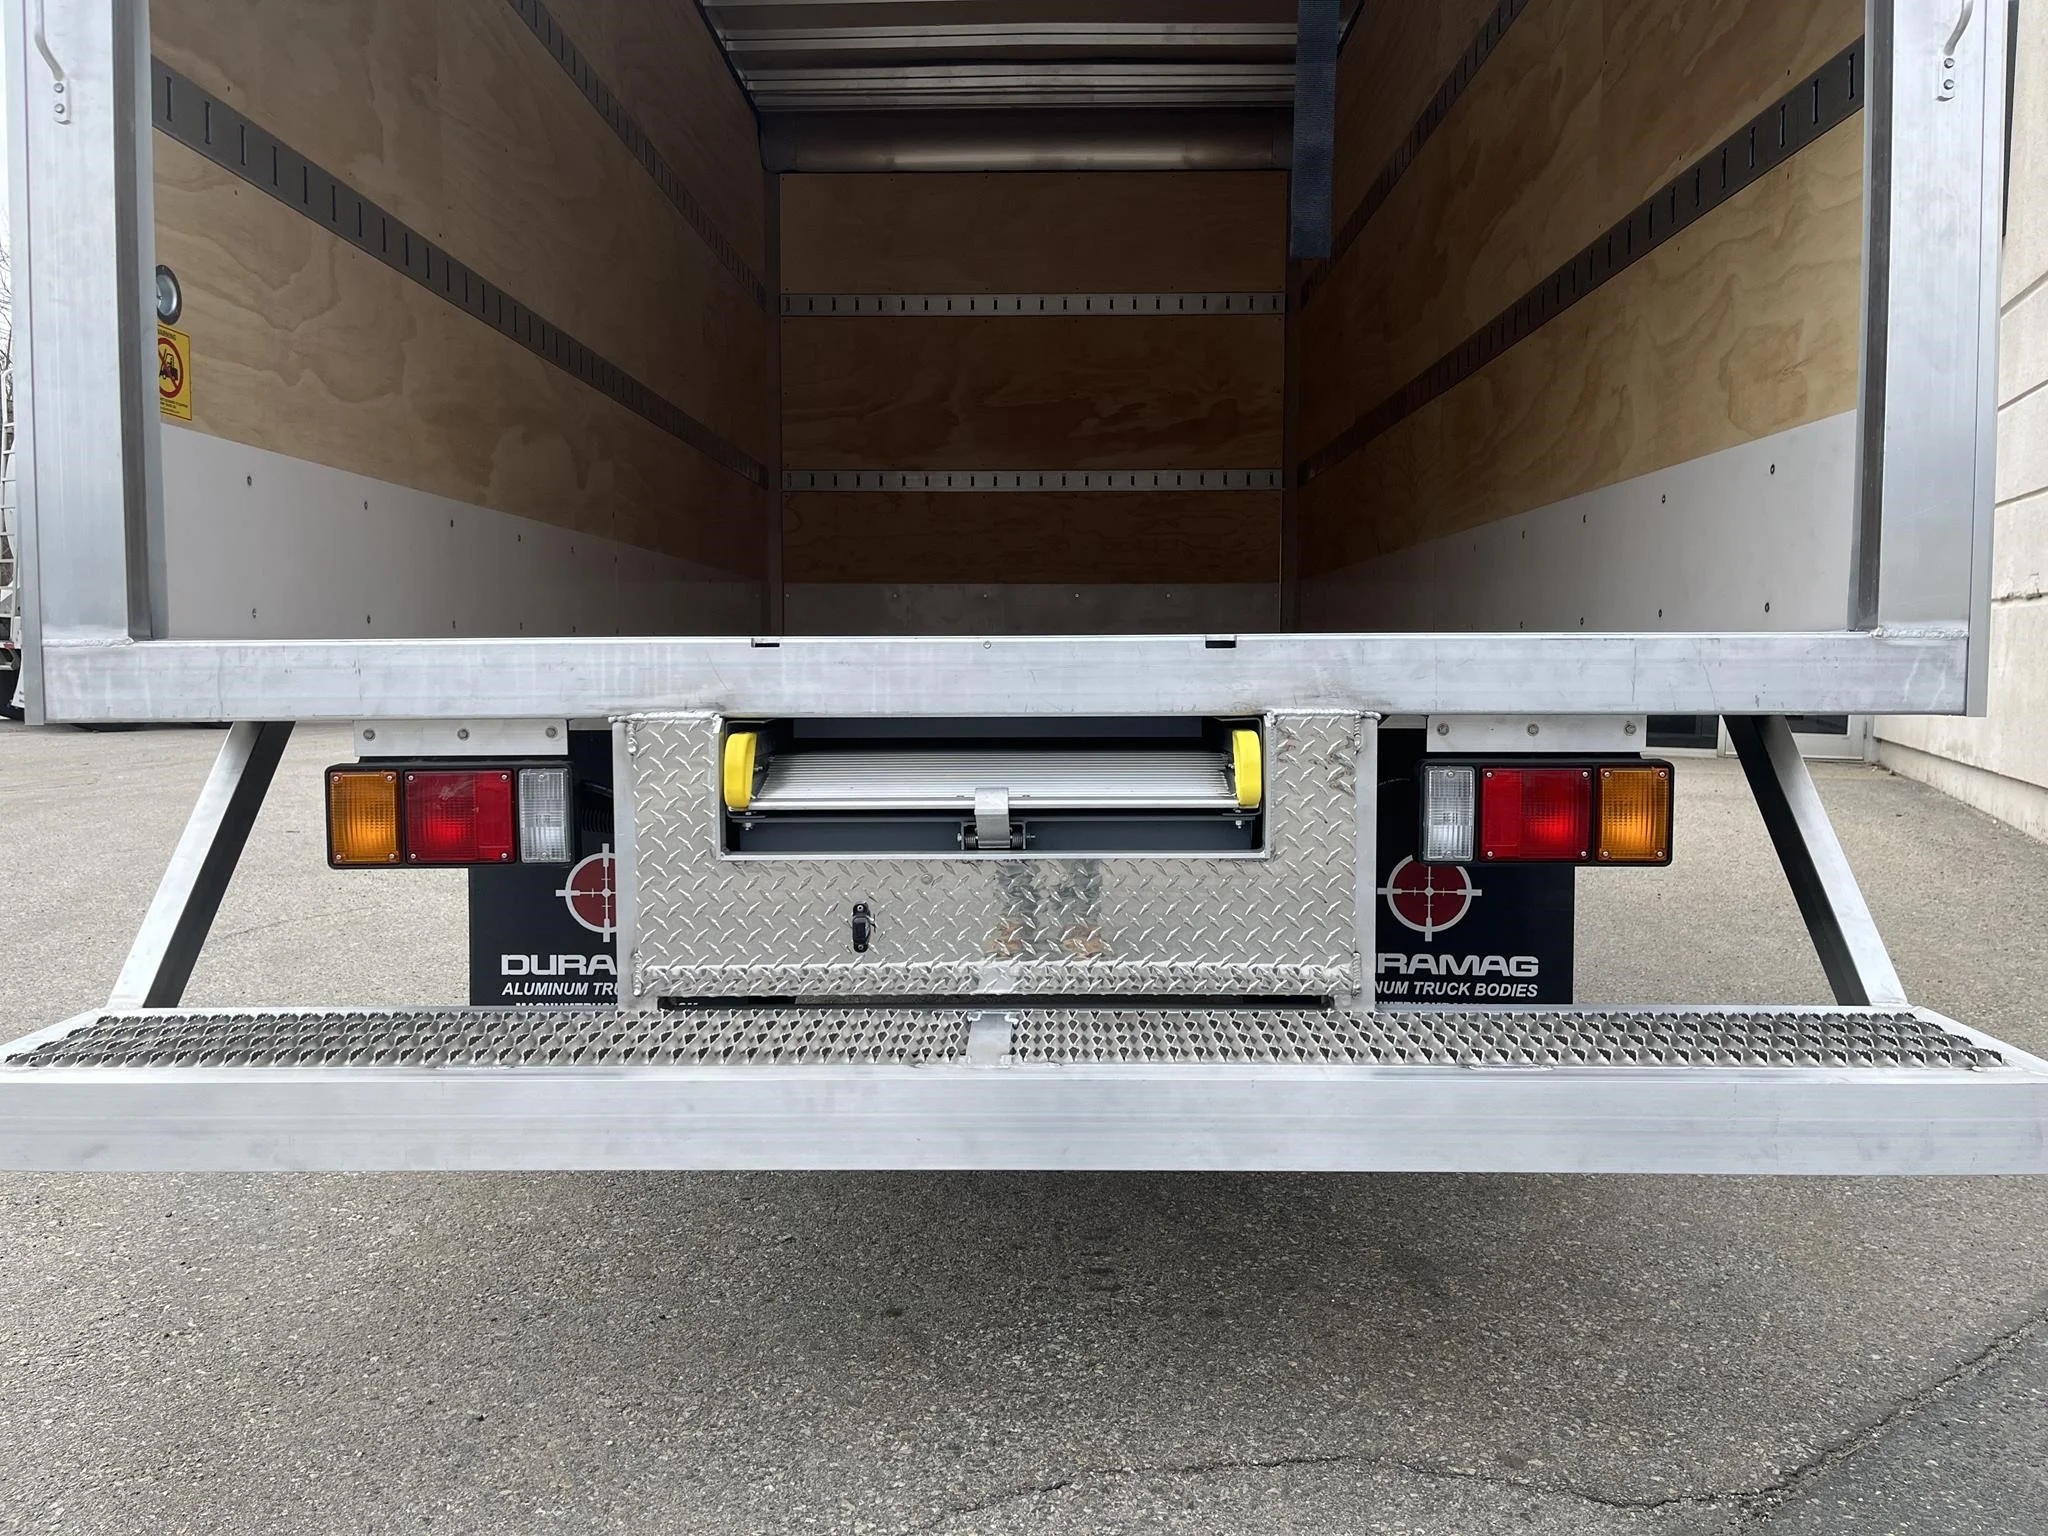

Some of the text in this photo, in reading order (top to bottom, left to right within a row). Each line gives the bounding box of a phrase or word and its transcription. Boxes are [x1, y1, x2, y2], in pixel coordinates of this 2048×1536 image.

[501, 954, 618, 975] DURA
[501, 982, 589, 995] ALUMINUM
[1413, 981, 1472, 996] TRUCK
[1474, 983, 1538, 998] BODIES
